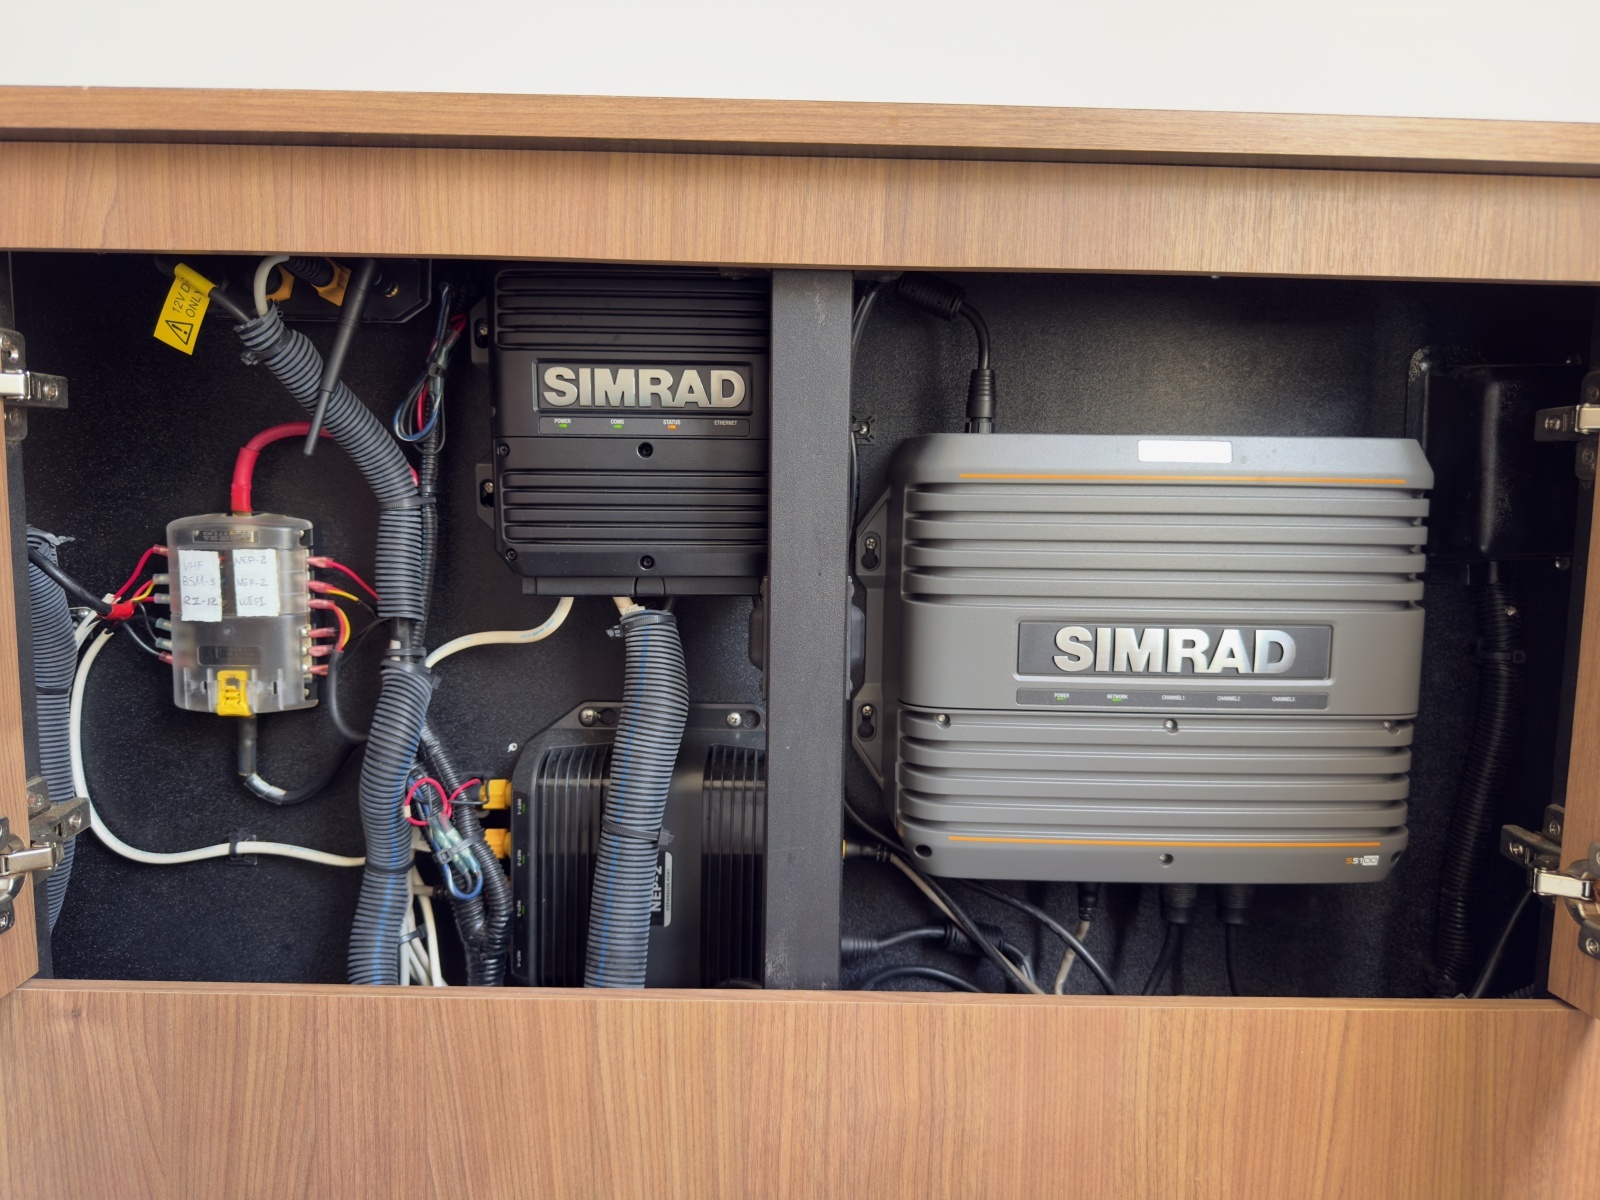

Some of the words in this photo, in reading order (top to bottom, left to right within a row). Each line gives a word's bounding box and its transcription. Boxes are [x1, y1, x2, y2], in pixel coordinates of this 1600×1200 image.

[171, 292, 186, 314] 12V
[185, 290, 204, 318] ONLY
[543, 366, 746, 408] SIMRAD
[183, 561, 203, 571] VHF
[234, 555, 268, 566] NEP-2
[182, 575, 216, 587] BSM-3
[236, 577, 269, 587] NEP-2
[183, 595, 219, 606] RI-12
[1053, 626, 1296, 674] SIMRAD
